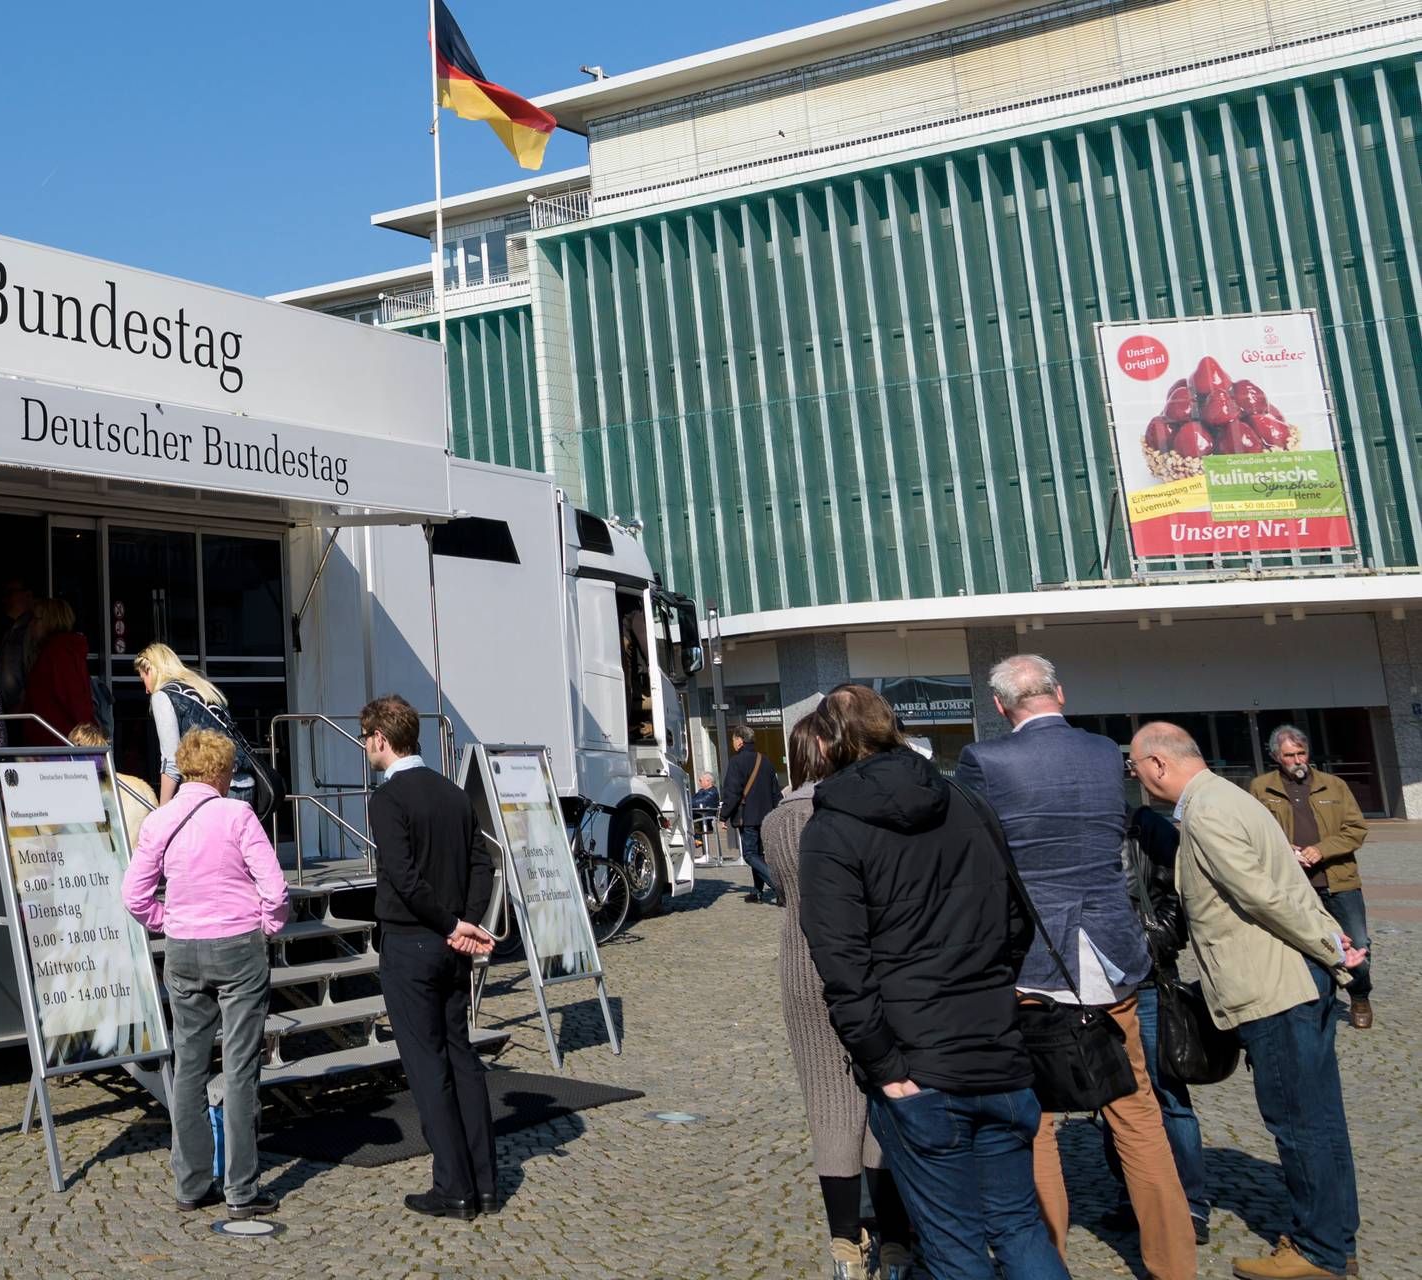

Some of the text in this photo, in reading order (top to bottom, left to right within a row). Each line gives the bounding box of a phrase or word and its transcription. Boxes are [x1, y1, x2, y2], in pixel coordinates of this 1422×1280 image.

[1127, 346, 1154, 358] Unser
[1125, 354, 1165, 371] Original
[21, 397, 350, 496] Deutscher Bundestag
[1209, 466, 1318, 485] kulinarische
[1132, 482, 1203, 505] Eröffnungstag mit
[1252, 475, 1337, 497] Symphonie
[1294, 490, 1322, 500] Herne
[1135, 498, 1181, 515] Livemusik
[1170, 519, 1310, 542] Unsere Nr. 1
[893, 701, 970, 711] AMBER BLUMEN
[18, 850, 65, 866] Montag
[522, 846, 544, 858] Testen
[24, 878, 47, 892] 9.00
[59, 875, 87, 890] 18.00
[88, 872, 110, 886] Uhr
[527, 868, 562, 880] Ihr Wissen
[527, 889, 572, 904] zum Parlament
[28, 904, 83, 920] Dienstag
[33, 934, 56, 947] 9.00
[68, 930, 96, 945] 18.00
[99, 926, 120, 941] Uhr
[36, 955, 96, 978] Mittwoch
[43, 991, 67, 1005] 9.00
[78, 987, 108, 1002] 14.00
[109, 983, 131, 997] Uhr
